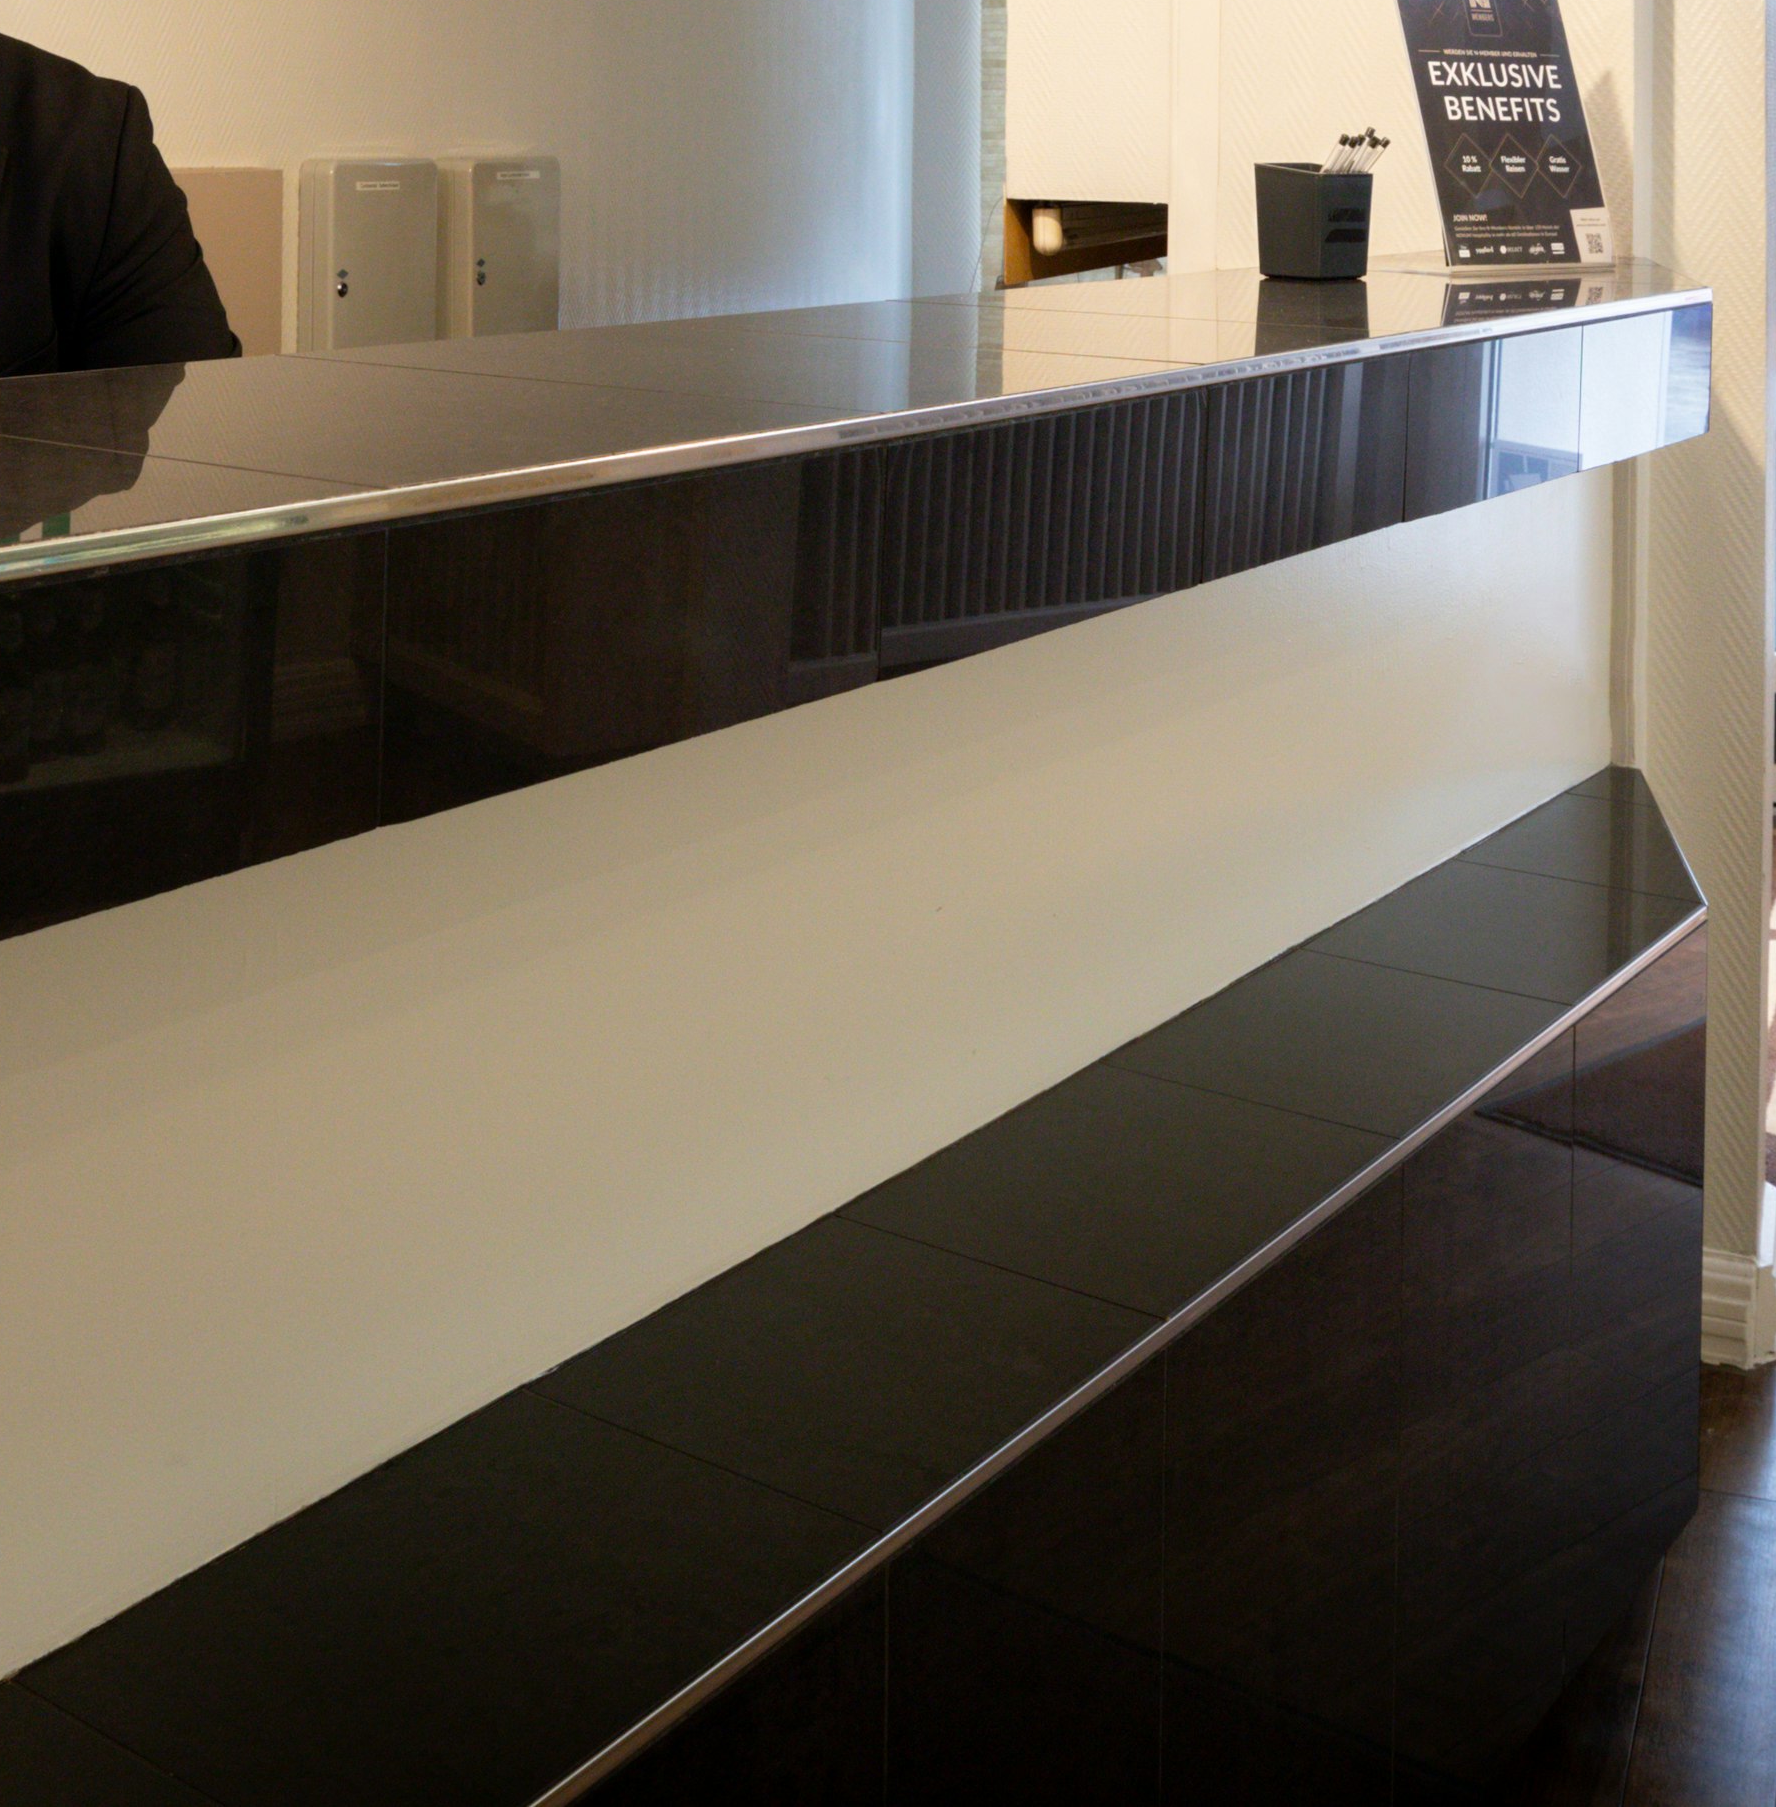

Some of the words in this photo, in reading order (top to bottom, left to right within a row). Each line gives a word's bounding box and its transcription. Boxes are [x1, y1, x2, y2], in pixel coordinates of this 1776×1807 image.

[1428, 61, 1562, 89] EXKLUSIVE
[1444, 96, 1561, 122] BENEFITS
[1453, 214, 1468, 222] JOIN
